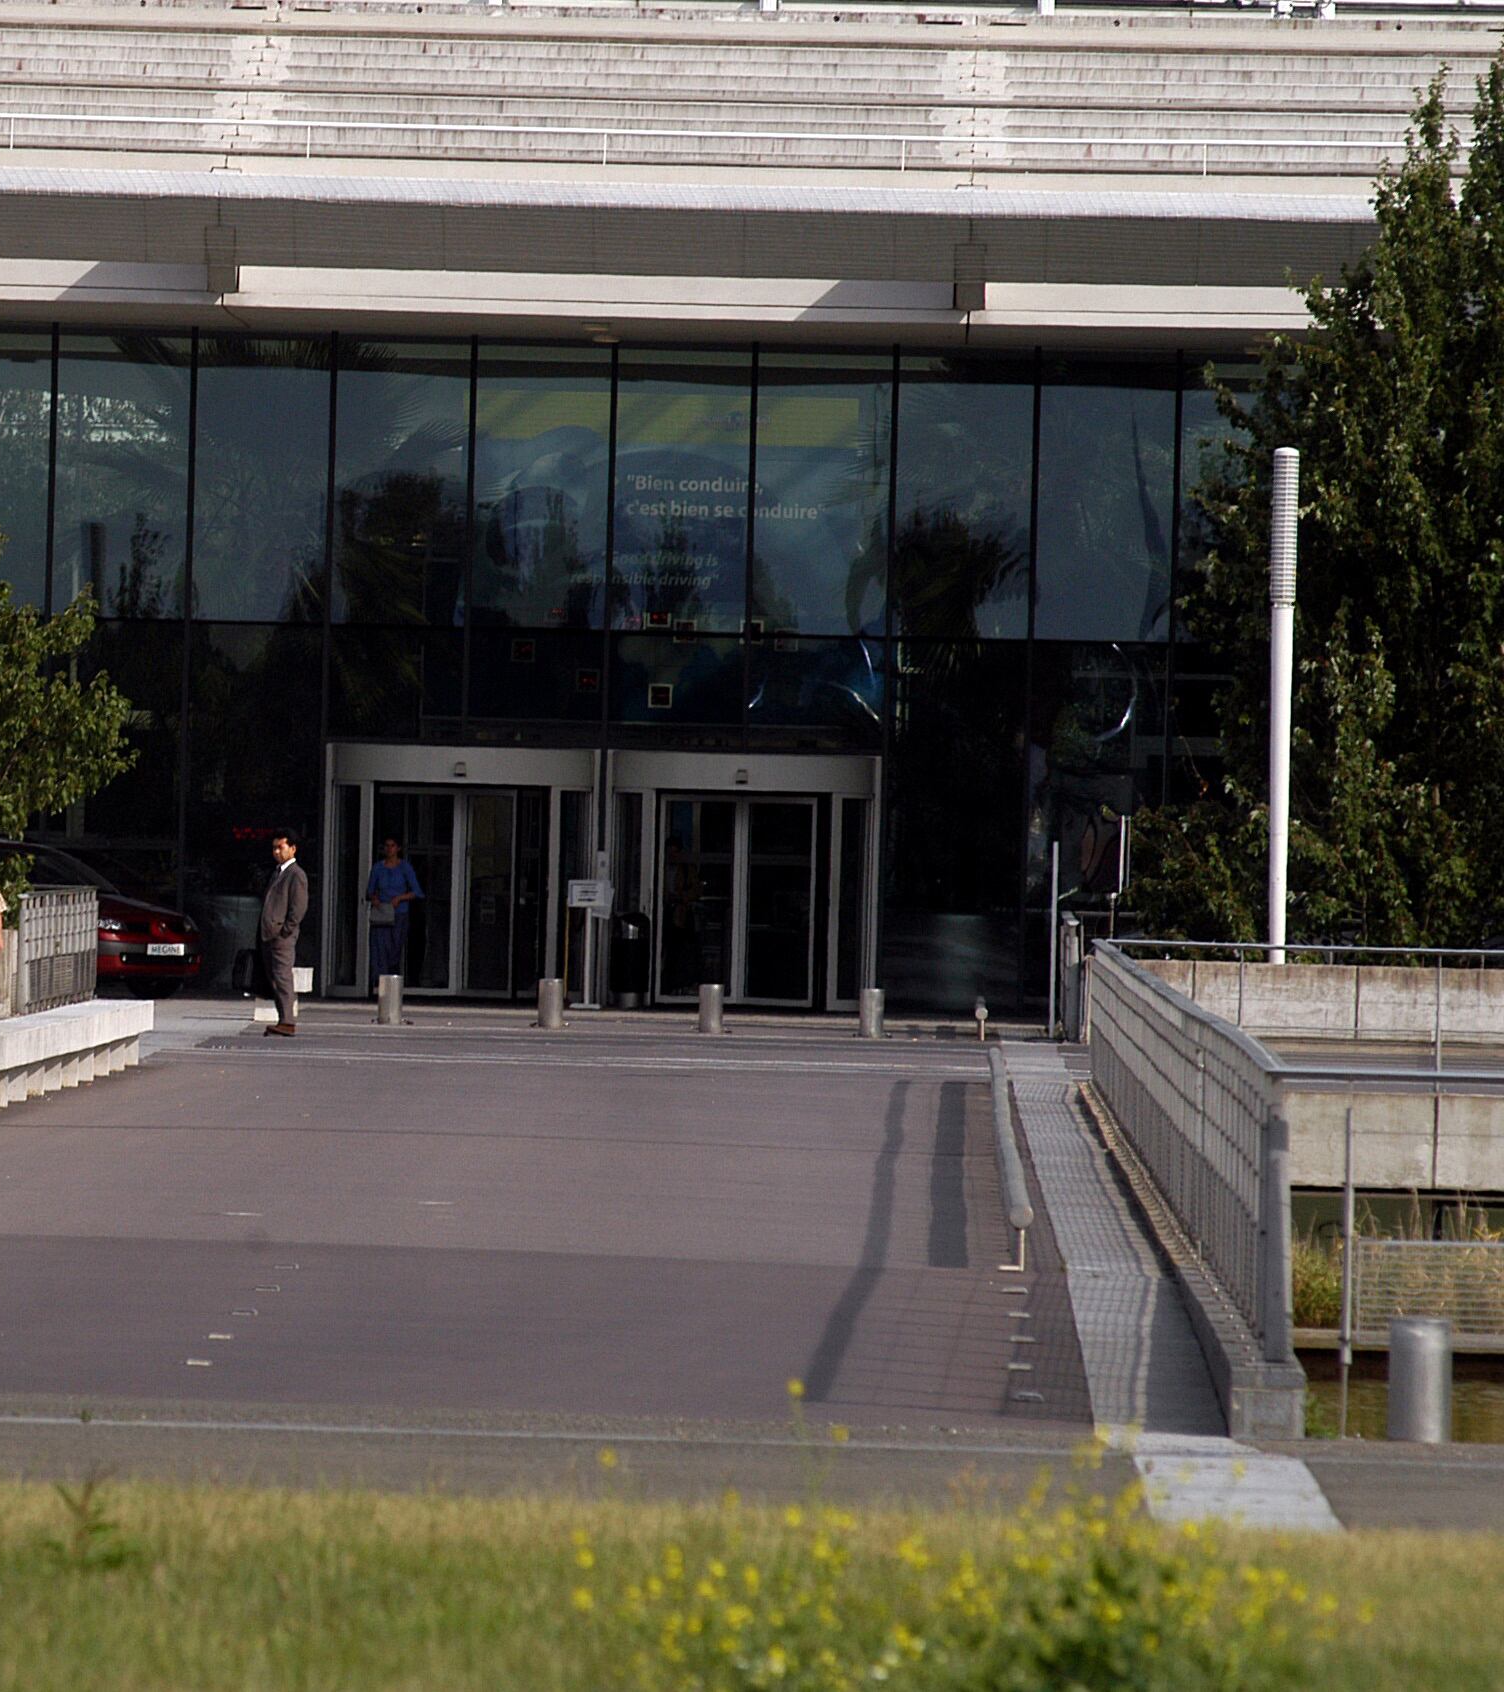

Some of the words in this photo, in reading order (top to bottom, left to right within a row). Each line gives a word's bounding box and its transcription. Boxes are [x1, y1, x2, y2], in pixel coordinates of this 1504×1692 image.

[627, 474, 675, 492] "Bien
[626, 500, 666, 515] c'est
[670, 500, 709, 518] bien
[713, 504, 734, 518] se
[570, 571, 655, 588] respnsible
